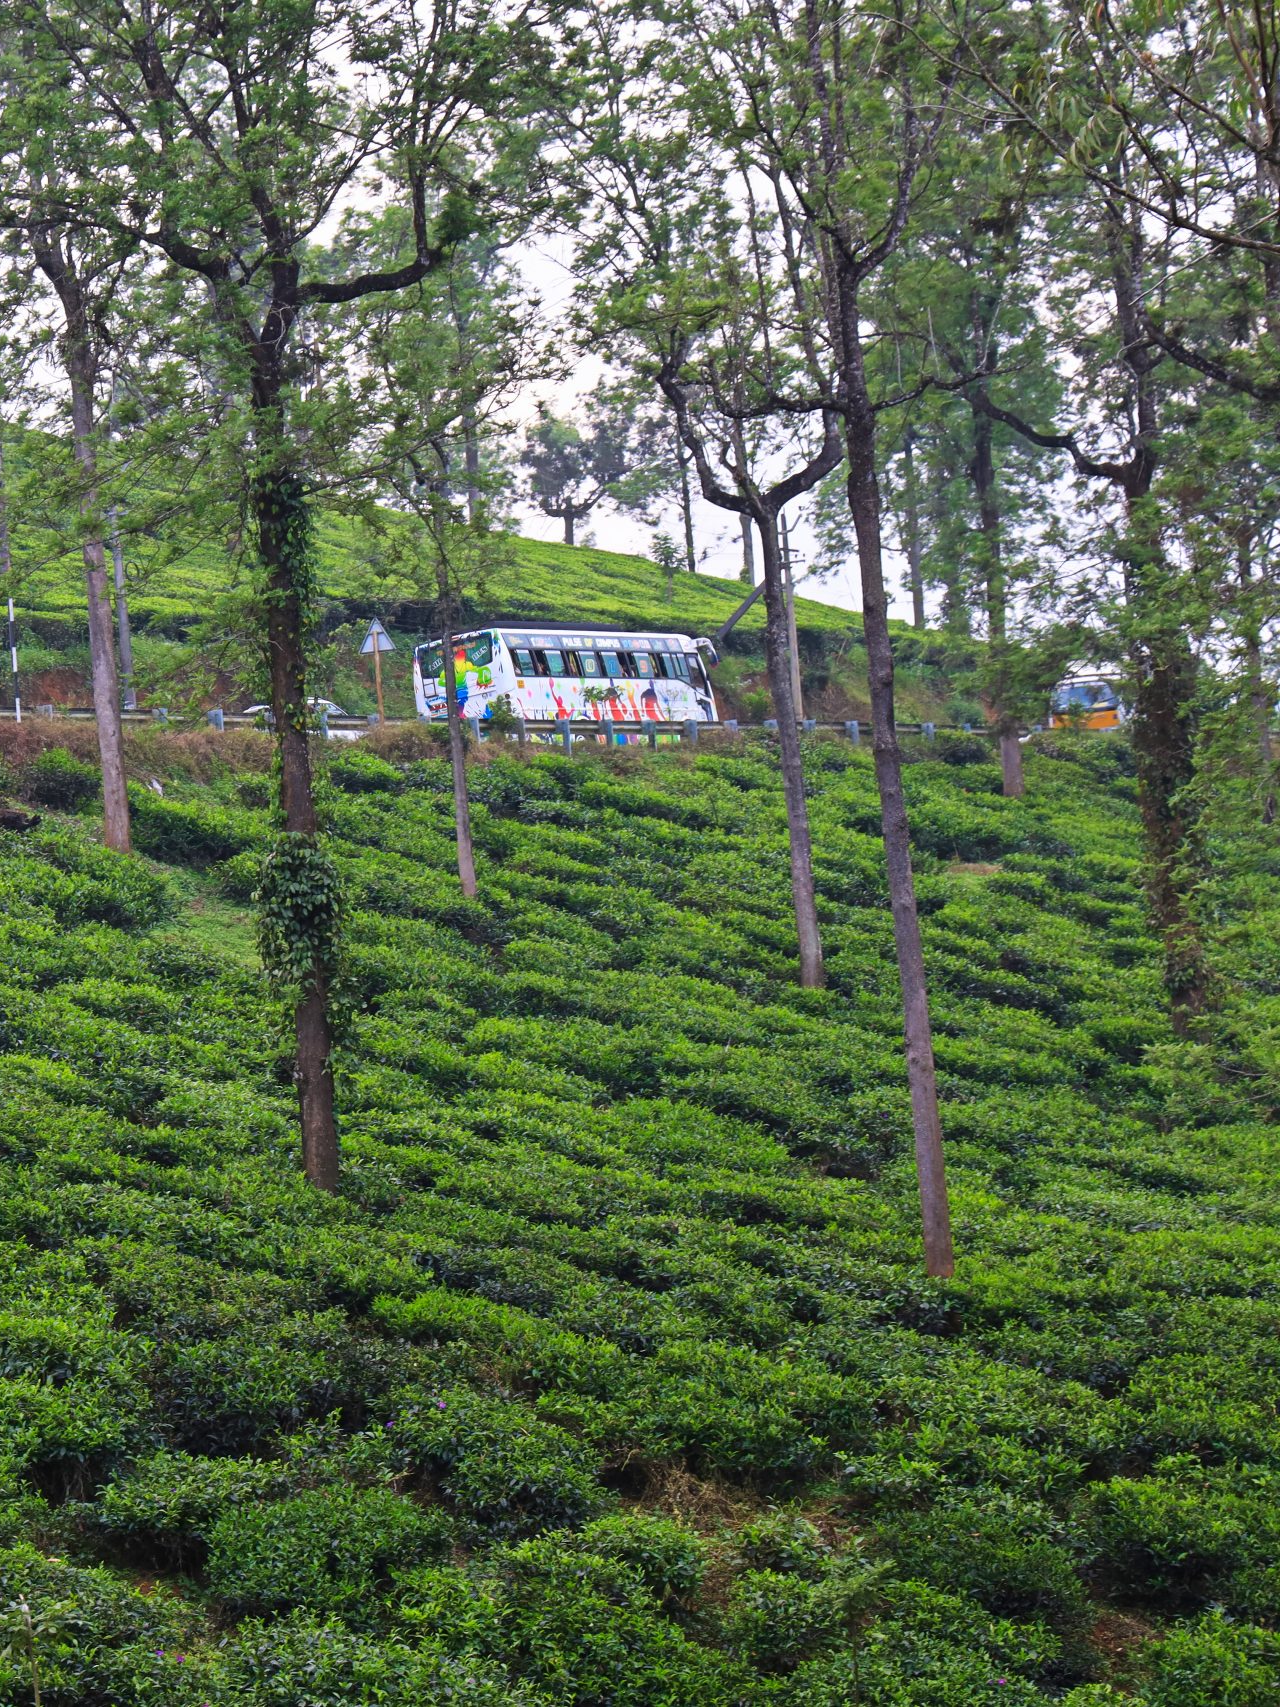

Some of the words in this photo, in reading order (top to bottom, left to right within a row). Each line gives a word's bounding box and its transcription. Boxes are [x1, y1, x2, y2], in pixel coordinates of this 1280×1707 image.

[562, 638, 583, 647] PULSE
[583, 637, 593, 648] OF
[594, 638, 621, 649] CAMPUS
